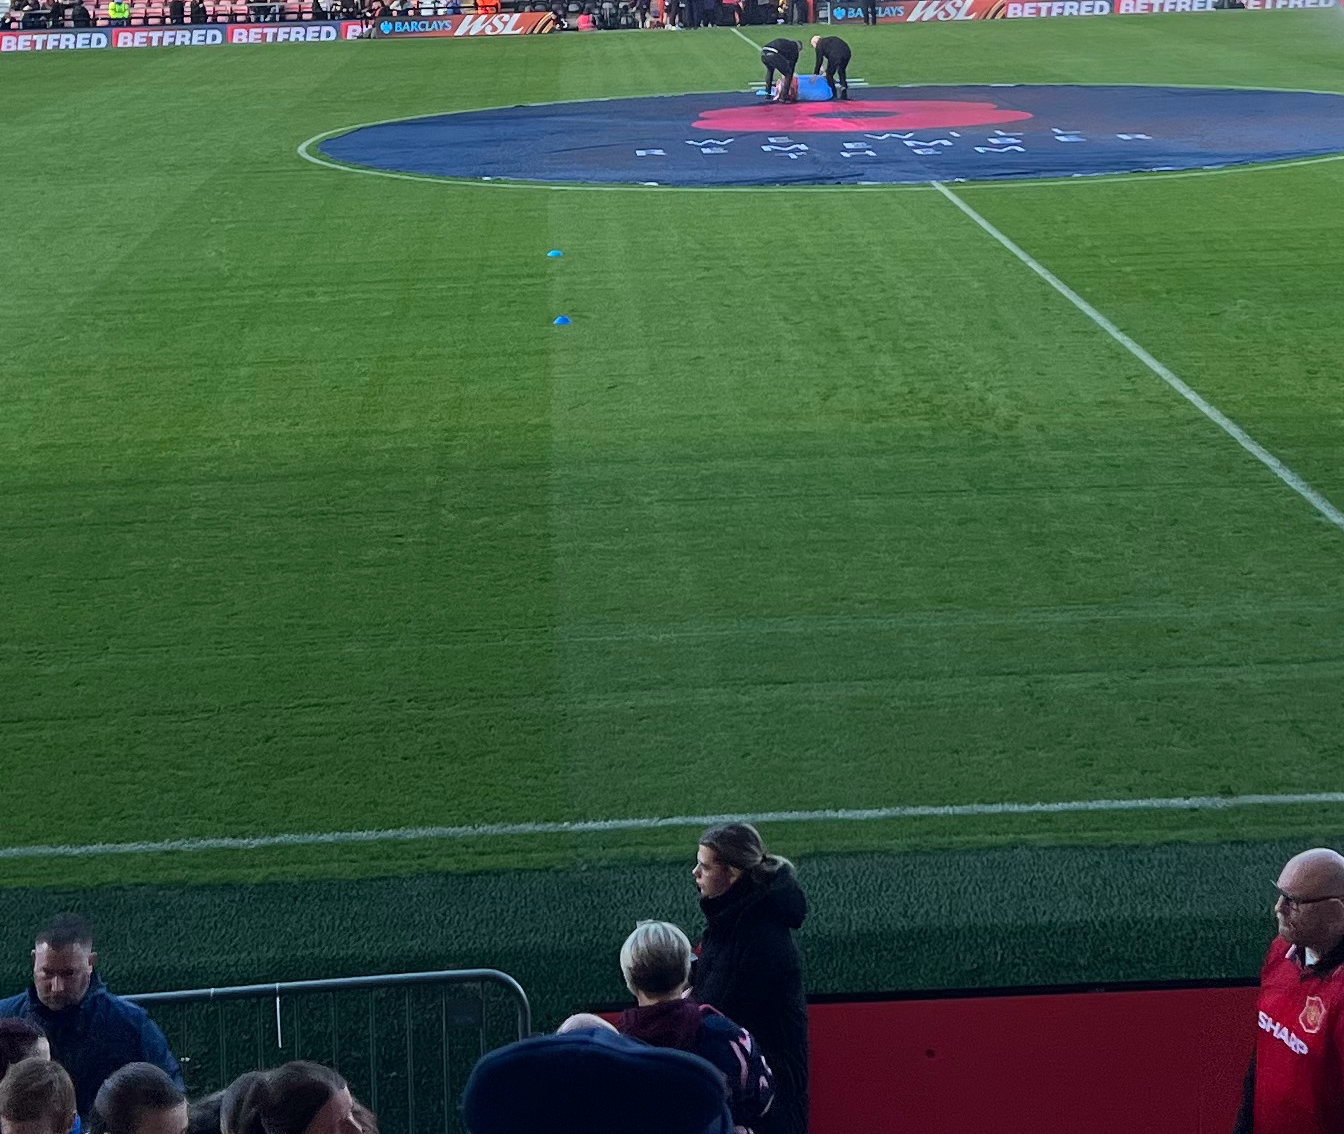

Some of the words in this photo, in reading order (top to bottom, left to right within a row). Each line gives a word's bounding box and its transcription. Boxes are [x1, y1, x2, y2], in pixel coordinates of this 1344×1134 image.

[847, 6, 904, 18] BALAYS
[906, 0, 978, 22] WSL
[1007, 0, 1110, 17] BETFRED
[395, 19, 452, 32] BARCLAYS
[454, 13, 524, 36] WSL
[1, 32, 107, 51] BETFRED
[117, 29, 223, 47] BETFRED
[233, 26, 336, 43] BETFRED
[1258, 1010, 1309, 1055] SHARP
